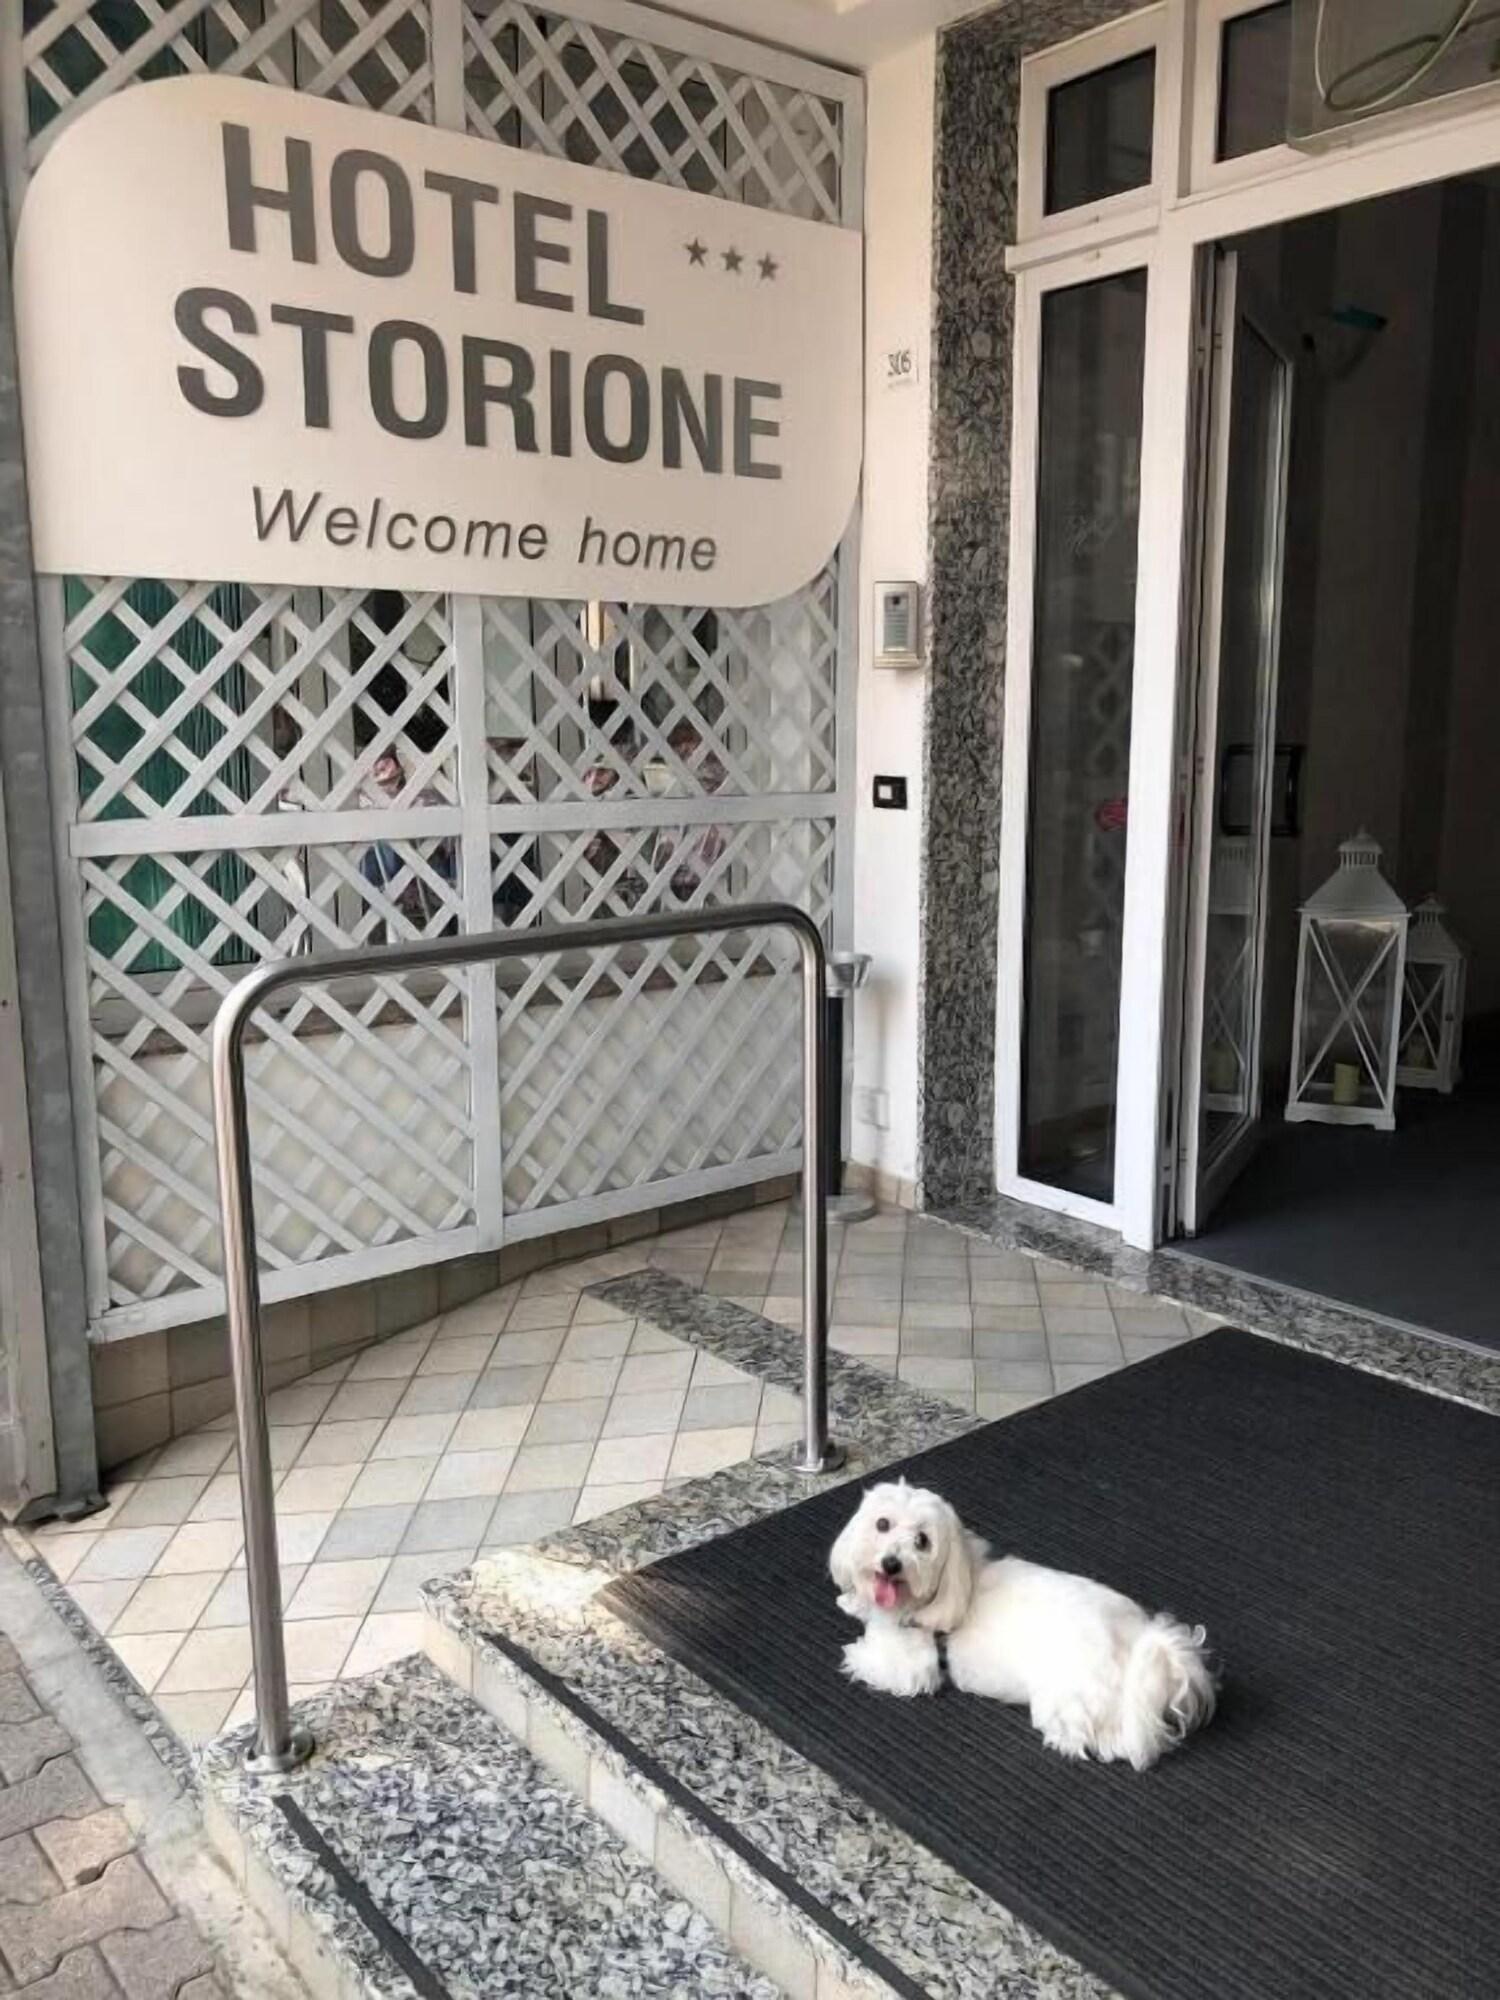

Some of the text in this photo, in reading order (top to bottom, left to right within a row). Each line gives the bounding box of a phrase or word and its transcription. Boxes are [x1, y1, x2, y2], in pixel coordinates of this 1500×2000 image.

[221, 121, 645, 327] HOTEL
[174, 286, 783, 480] STORIONE
[252, 485, 718, 572] Welcome home
